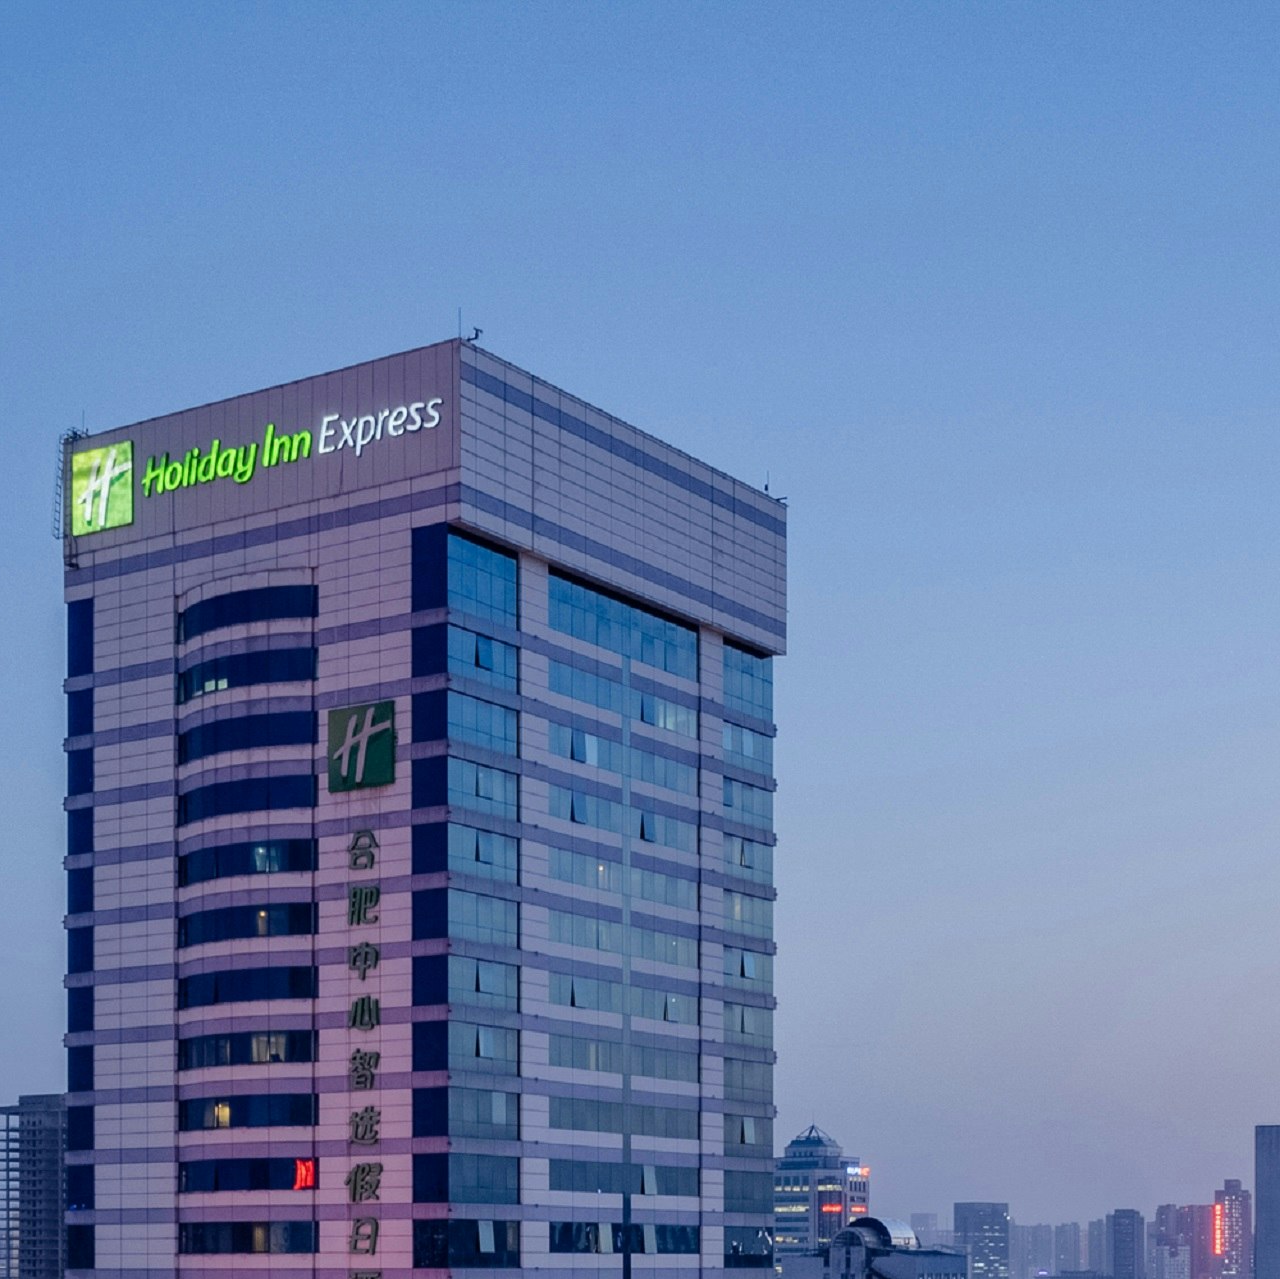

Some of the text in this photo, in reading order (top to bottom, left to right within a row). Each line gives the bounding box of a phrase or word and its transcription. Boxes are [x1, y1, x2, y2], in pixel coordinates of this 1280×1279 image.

[141, 397, 443, 497] Holiday Inn Express
